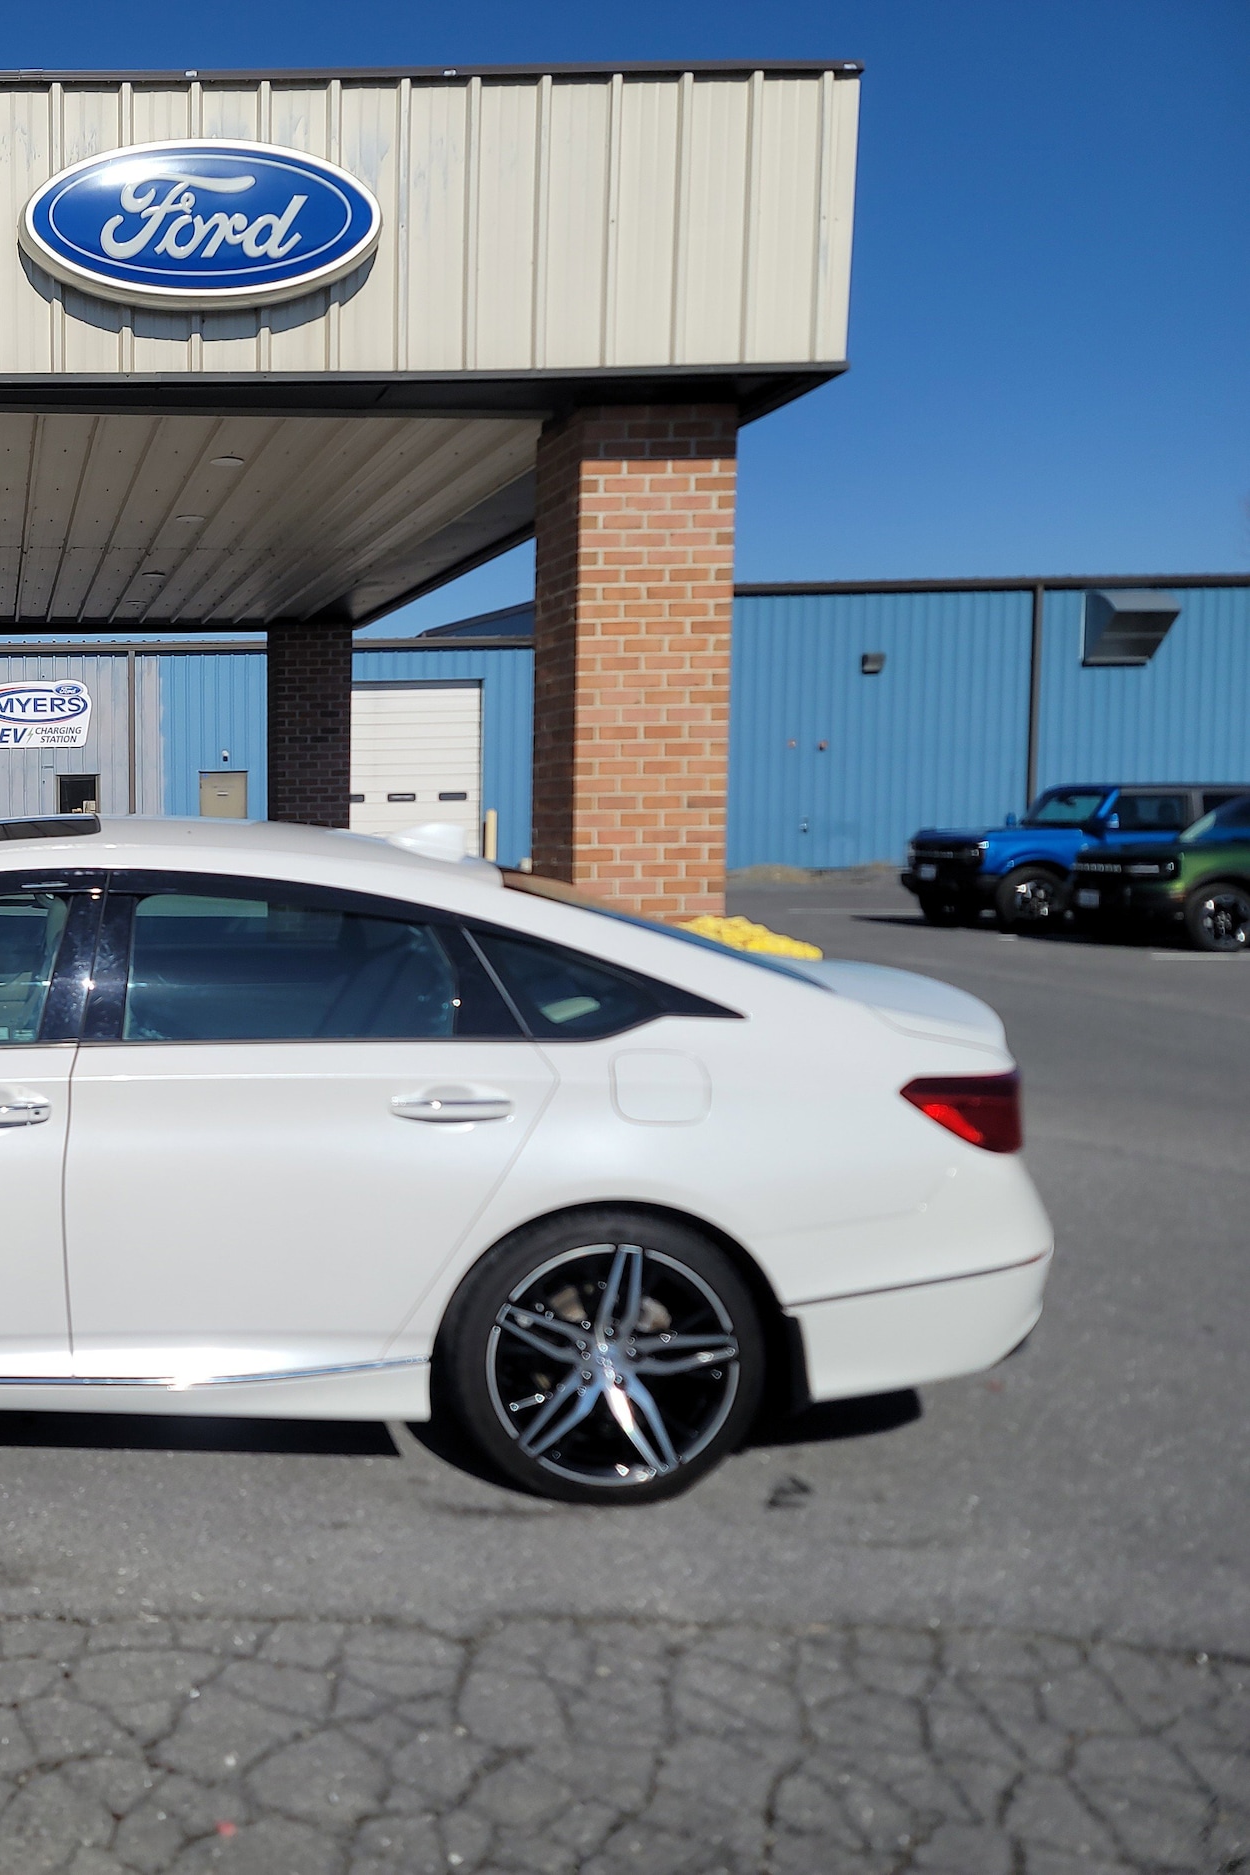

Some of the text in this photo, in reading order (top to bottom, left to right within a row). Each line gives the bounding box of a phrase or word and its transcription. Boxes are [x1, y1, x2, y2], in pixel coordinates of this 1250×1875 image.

[99, 173, 309, 259] Ford
[35, 727, 82, 735] CHARGING
[40, 735, 77, 743] STATION
